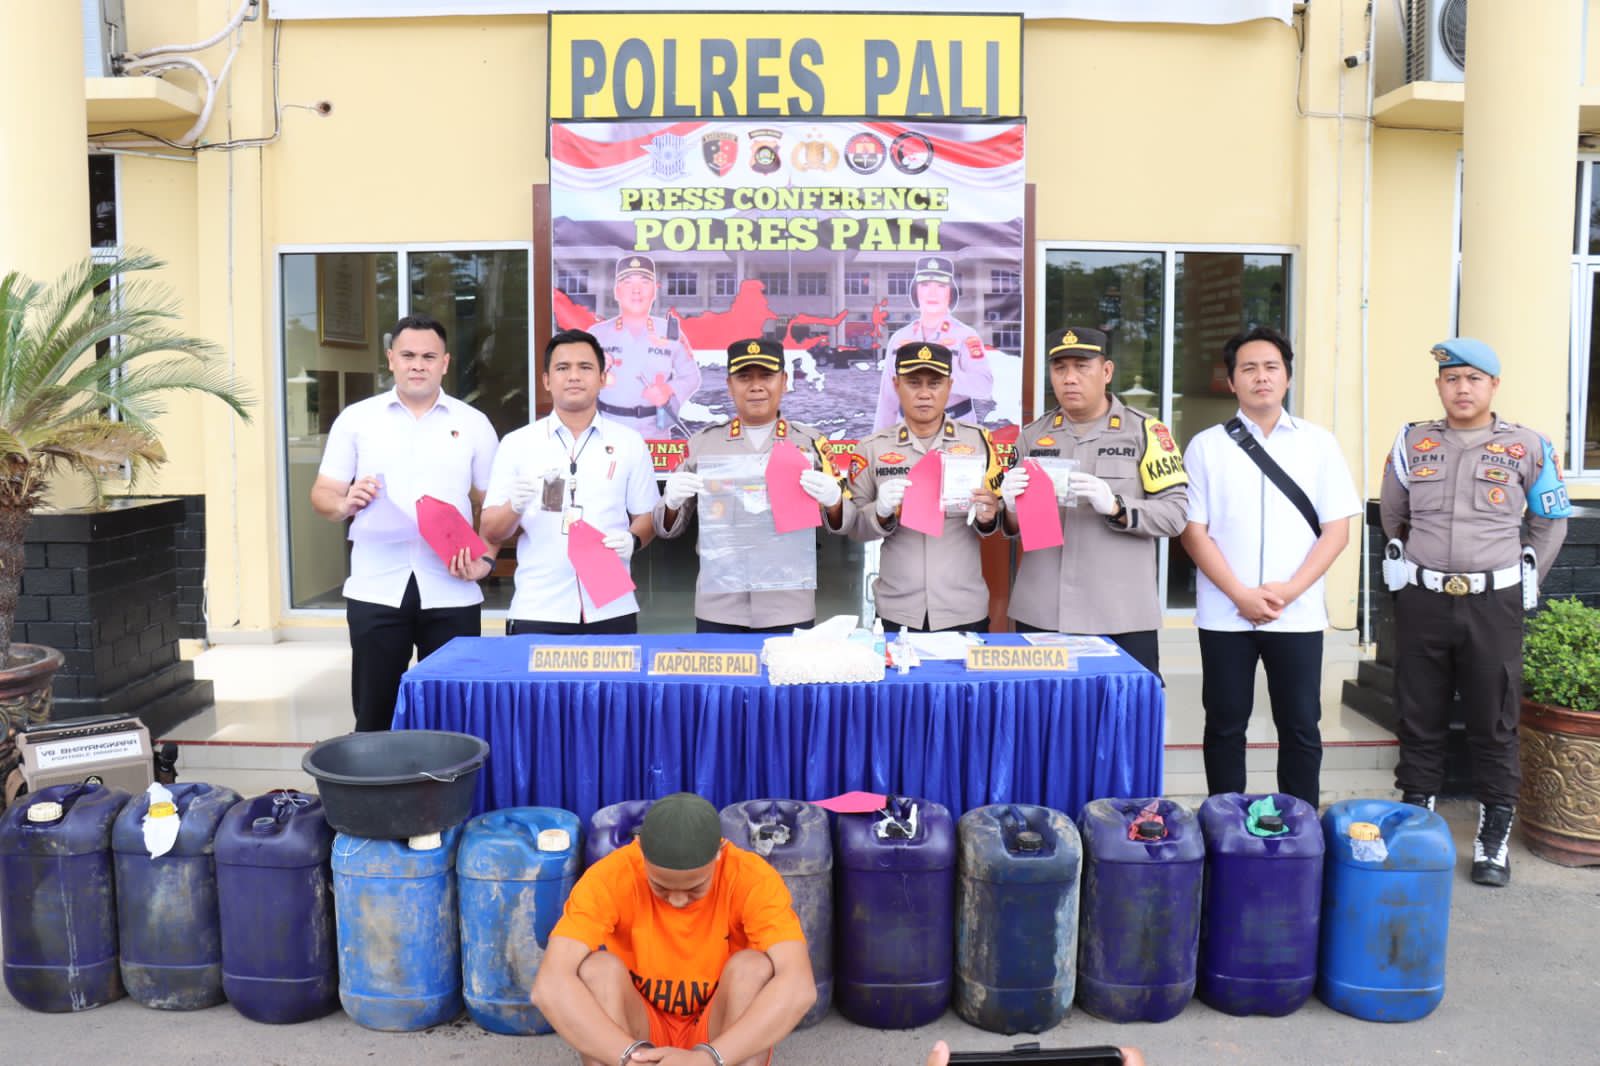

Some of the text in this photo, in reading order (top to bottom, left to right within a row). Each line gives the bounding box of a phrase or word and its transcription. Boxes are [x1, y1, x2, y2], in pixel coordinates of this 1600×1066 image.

[570, 38, 1000, 118] POLRES PALI
[620, 187, 948, 212] PRESS CONFERENCE
[633, 217, 942, 252] POLRES PALI
[1098, 447, 1136, 457] POLRI
[1412, 454, 1445, 464] DENI
[1481, 454, 1520, 469] POLRI
[534, 650, 633, 669] BARANG BUKTI
[657, 655, 753, 673] KAPOLRES PALI
[970, 648, 1066, 668] TERSANGKA
